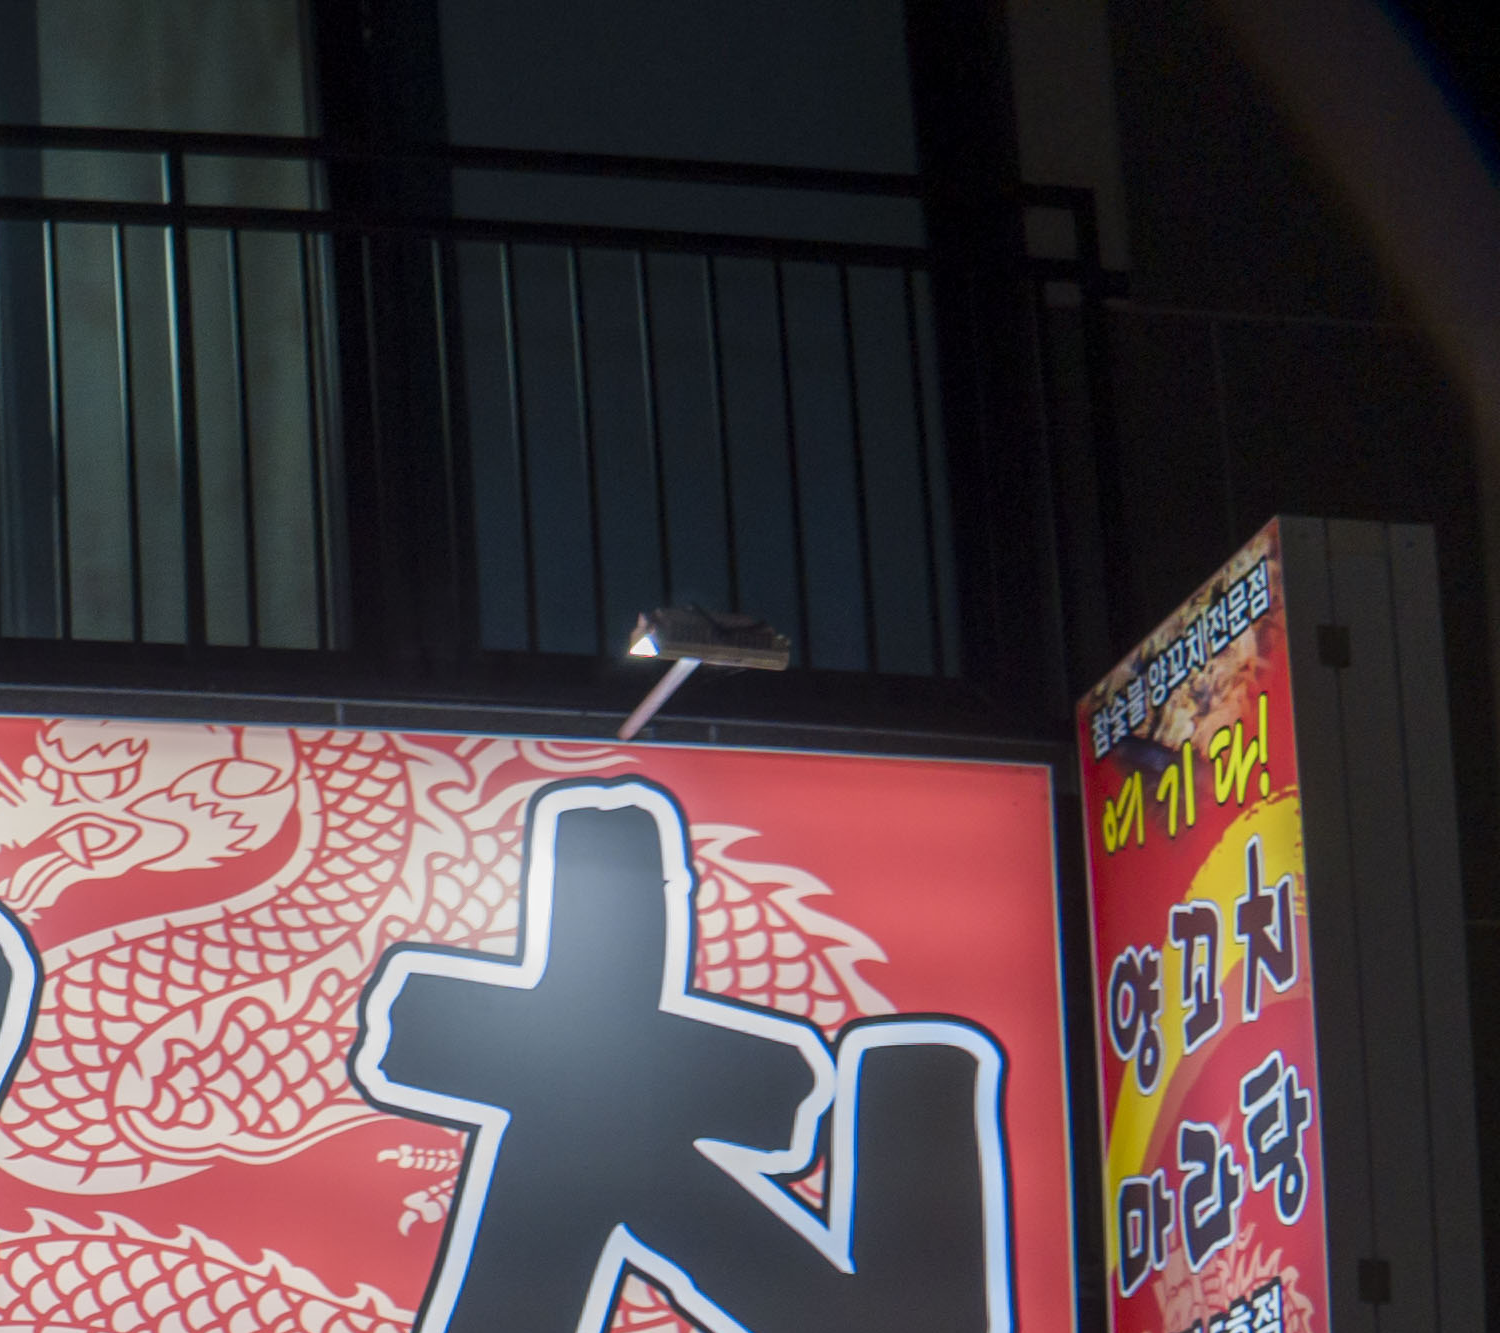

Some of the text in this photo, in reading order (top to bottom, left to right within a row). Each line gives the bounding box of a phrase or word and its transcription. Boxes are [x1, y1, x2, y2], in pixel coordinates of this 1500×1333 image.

[1146, 621, 1206, 708] 양꼬치
[1205, 556, 1271, 657] 전문점
[1102, 691, 1271, 855] 여기다!
[1107, 834, 1298, 1095] 양꼬치
[1117, 1050, 1312, 1298] 마라탕
